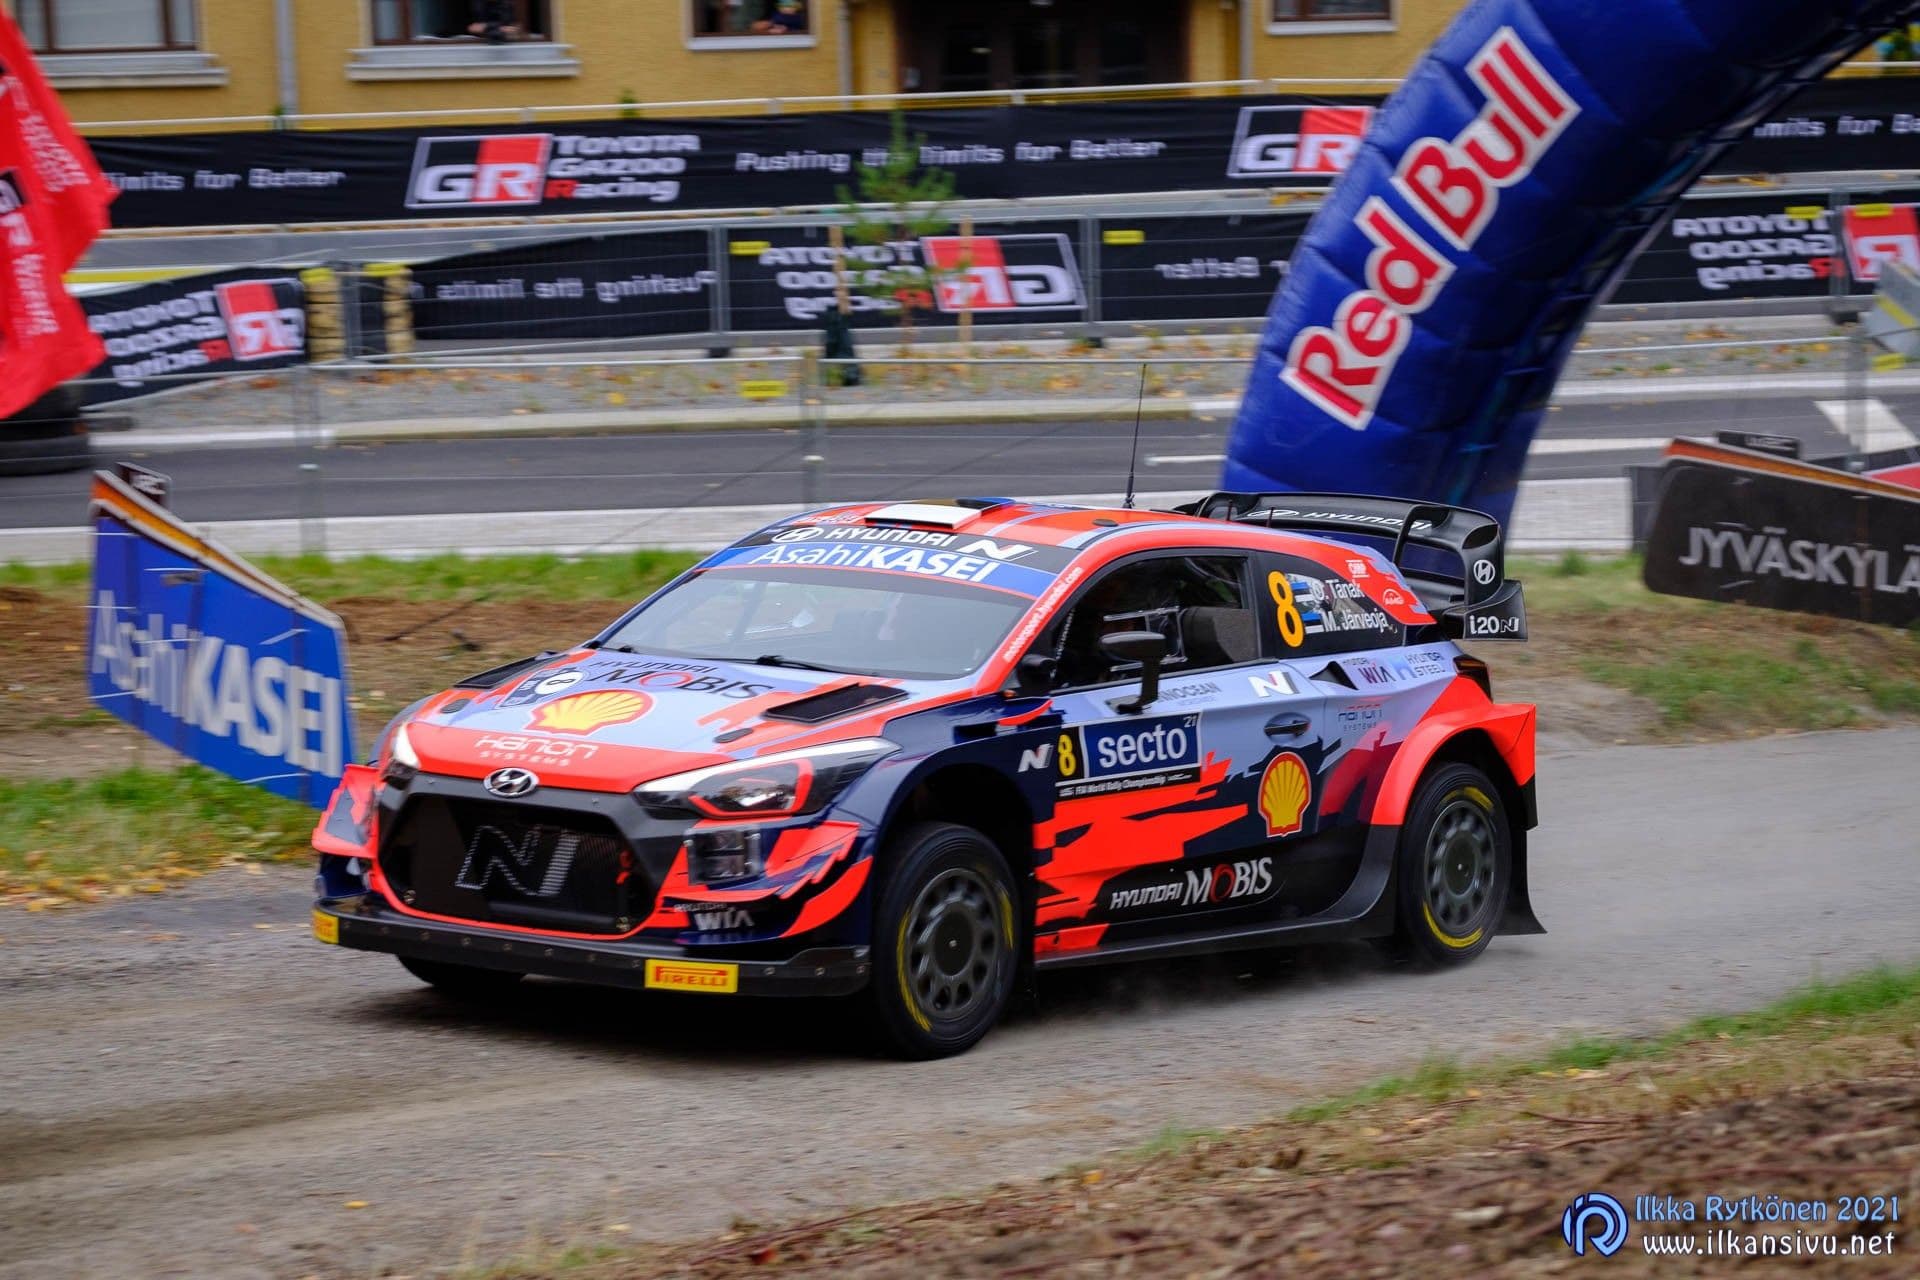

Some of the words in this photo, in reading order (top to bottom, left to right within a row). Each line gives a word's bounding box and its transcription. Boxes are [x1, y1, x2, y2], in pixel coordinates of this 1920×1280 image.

[550, 135, 700, 155] TOYOTA
[735, 151, 851, 174] Pushing
[919, 144, 1004, 165] limits
[1015, 142, 1062, 161] for
[1070, 139, 1167, 159] Better
[1237, 133, 1361, 170] GR
[194, 169, 242, 189] for
[248, 167, 347, 188] Better
[416, 163, 536, 201] GR
[548, 157, 687, 178] GAZOO
[544, 177, 681, 203] Racing
[1280, 196, 1455, 429] Red
[1390, 27, 1581, 250] Bull
[823, 527, 958, 548] HYUNDAI
[749, 544, 1000, 583] AsahiKASEI
[1267, 570, 1305, 648] 8
[585, 668, 776, 700] MOBIS
[589, 661, 718, 674] HYUNDAI
[1057, 733, 1077, 777] 8
[1097, 723, 1189, 769] secto
[1109, 881, 1184, 910] HYUNDAI
[1181, 856, 1273, 906] MOBIS
[654, 965, 729, 987] PIRELLI
